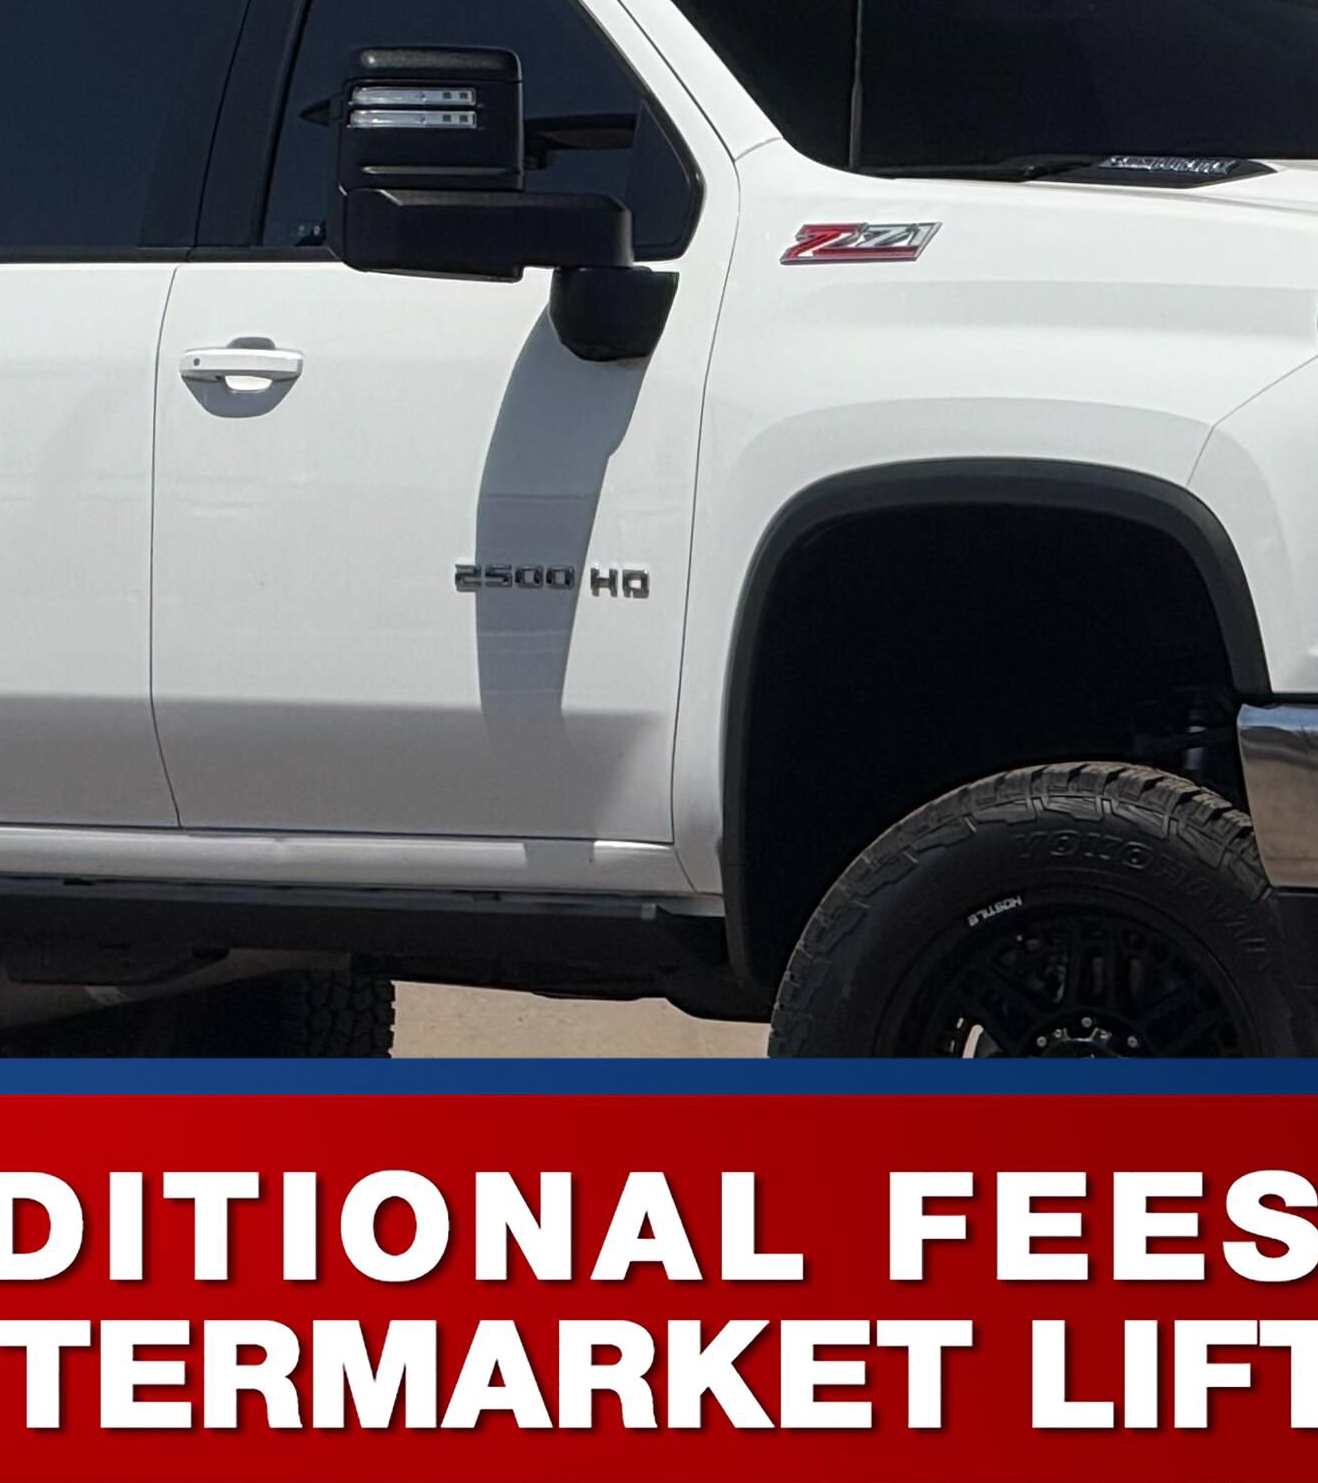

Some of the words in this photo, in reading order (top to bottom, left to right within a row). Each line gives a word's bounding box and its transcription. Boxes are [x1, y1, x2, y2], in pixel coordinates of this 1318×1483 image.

[780, 222, 942, 265] Z71
[455, 564, 575, 592] 2500
[590, 568, 649, 599] HD
